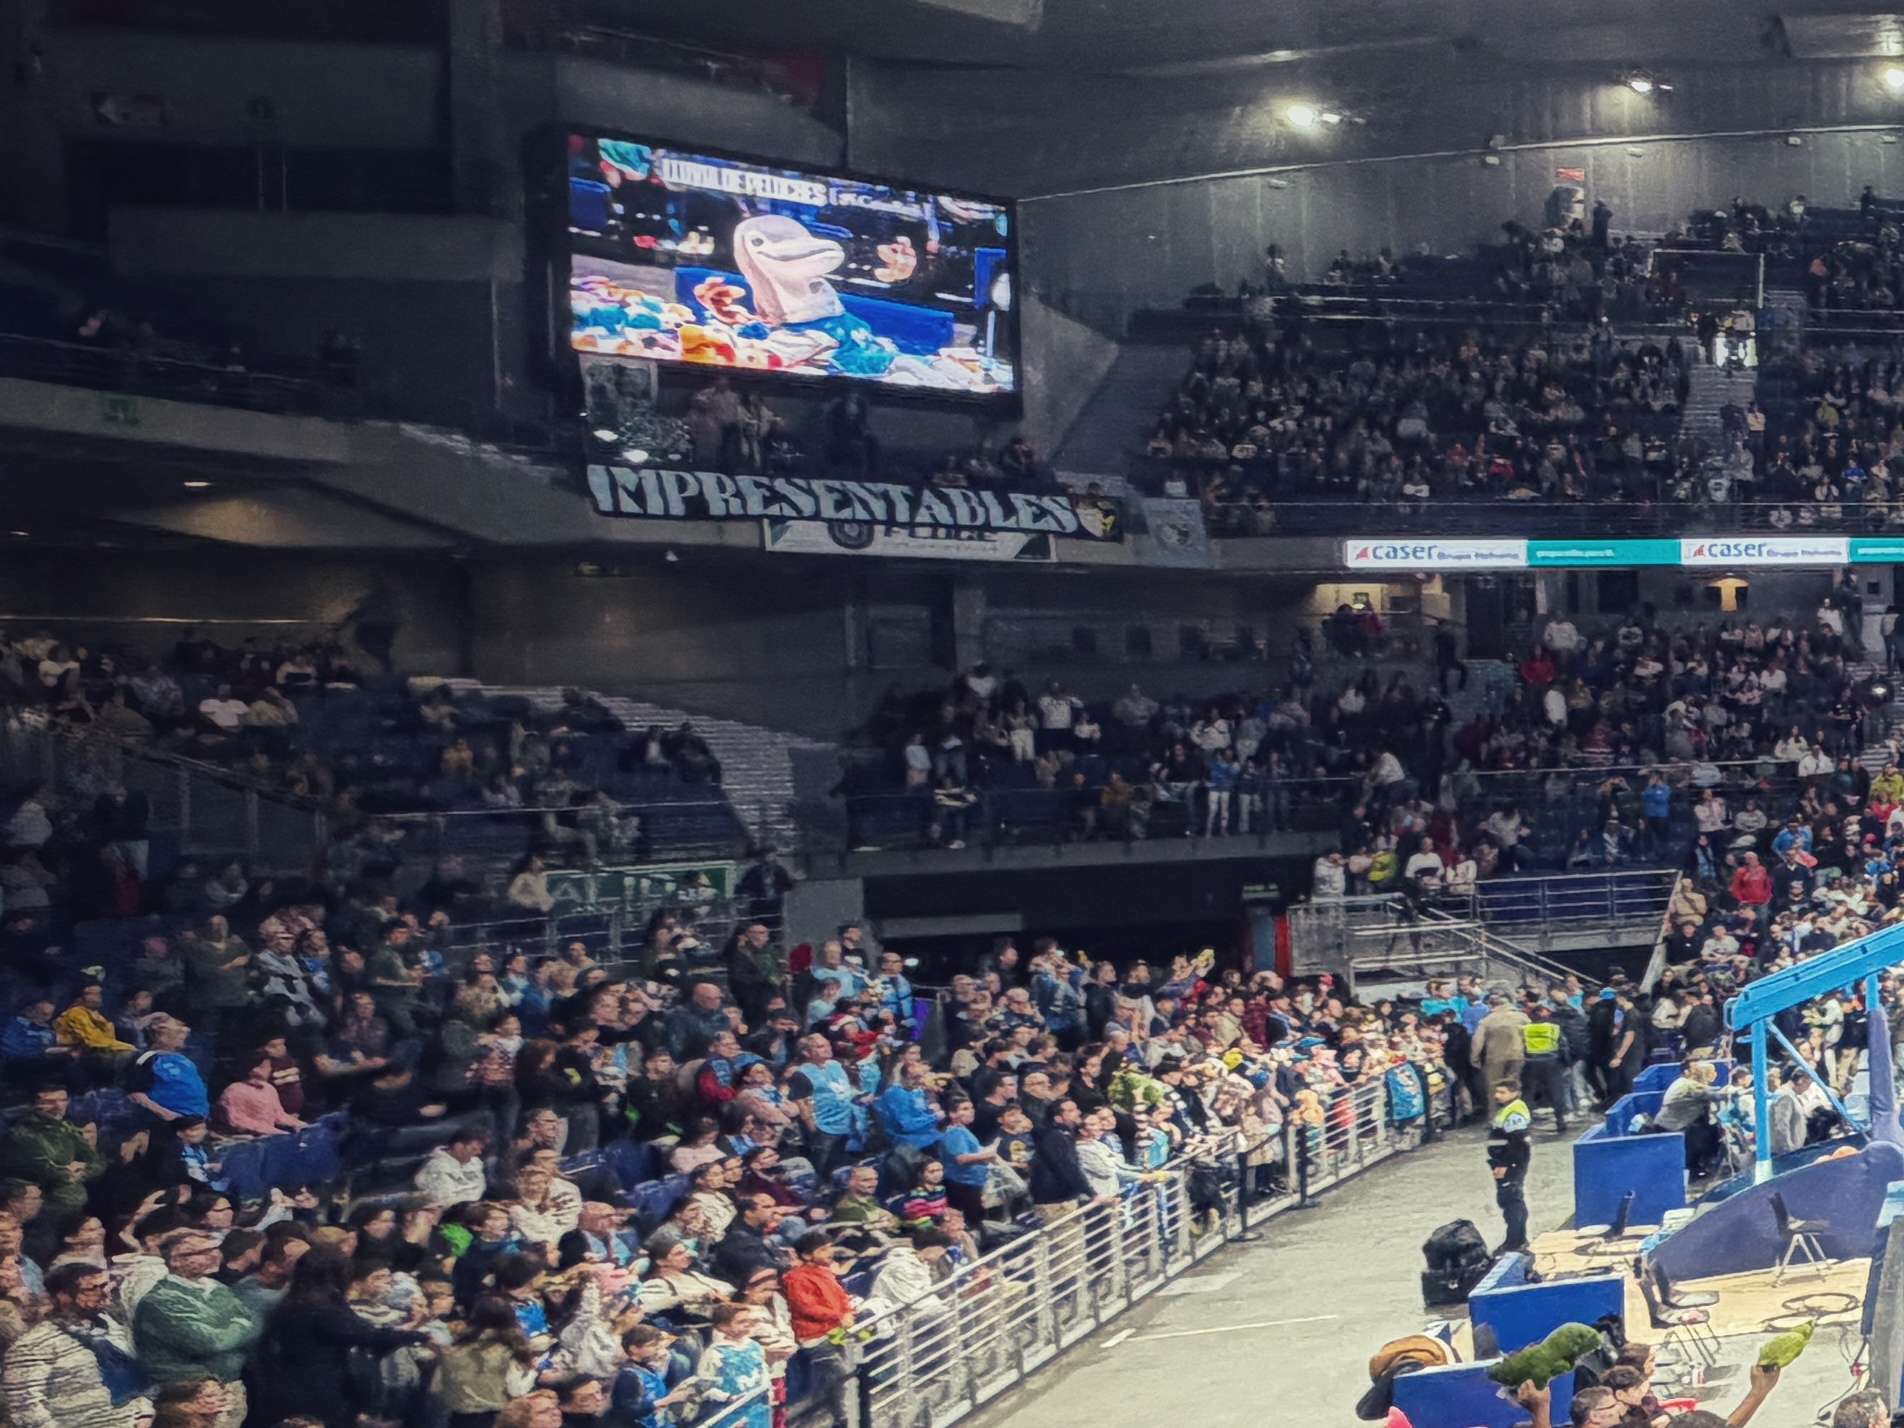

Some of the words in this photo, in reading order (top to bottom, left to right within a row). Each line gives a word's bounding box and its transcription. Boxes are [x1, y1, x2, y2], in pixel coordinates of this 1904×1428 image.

[588, 464, 1079, 533] IMPRESENTABLES
[1371, 544, 1437, 560] caser
[1707, 542, 1767, 557] caser
